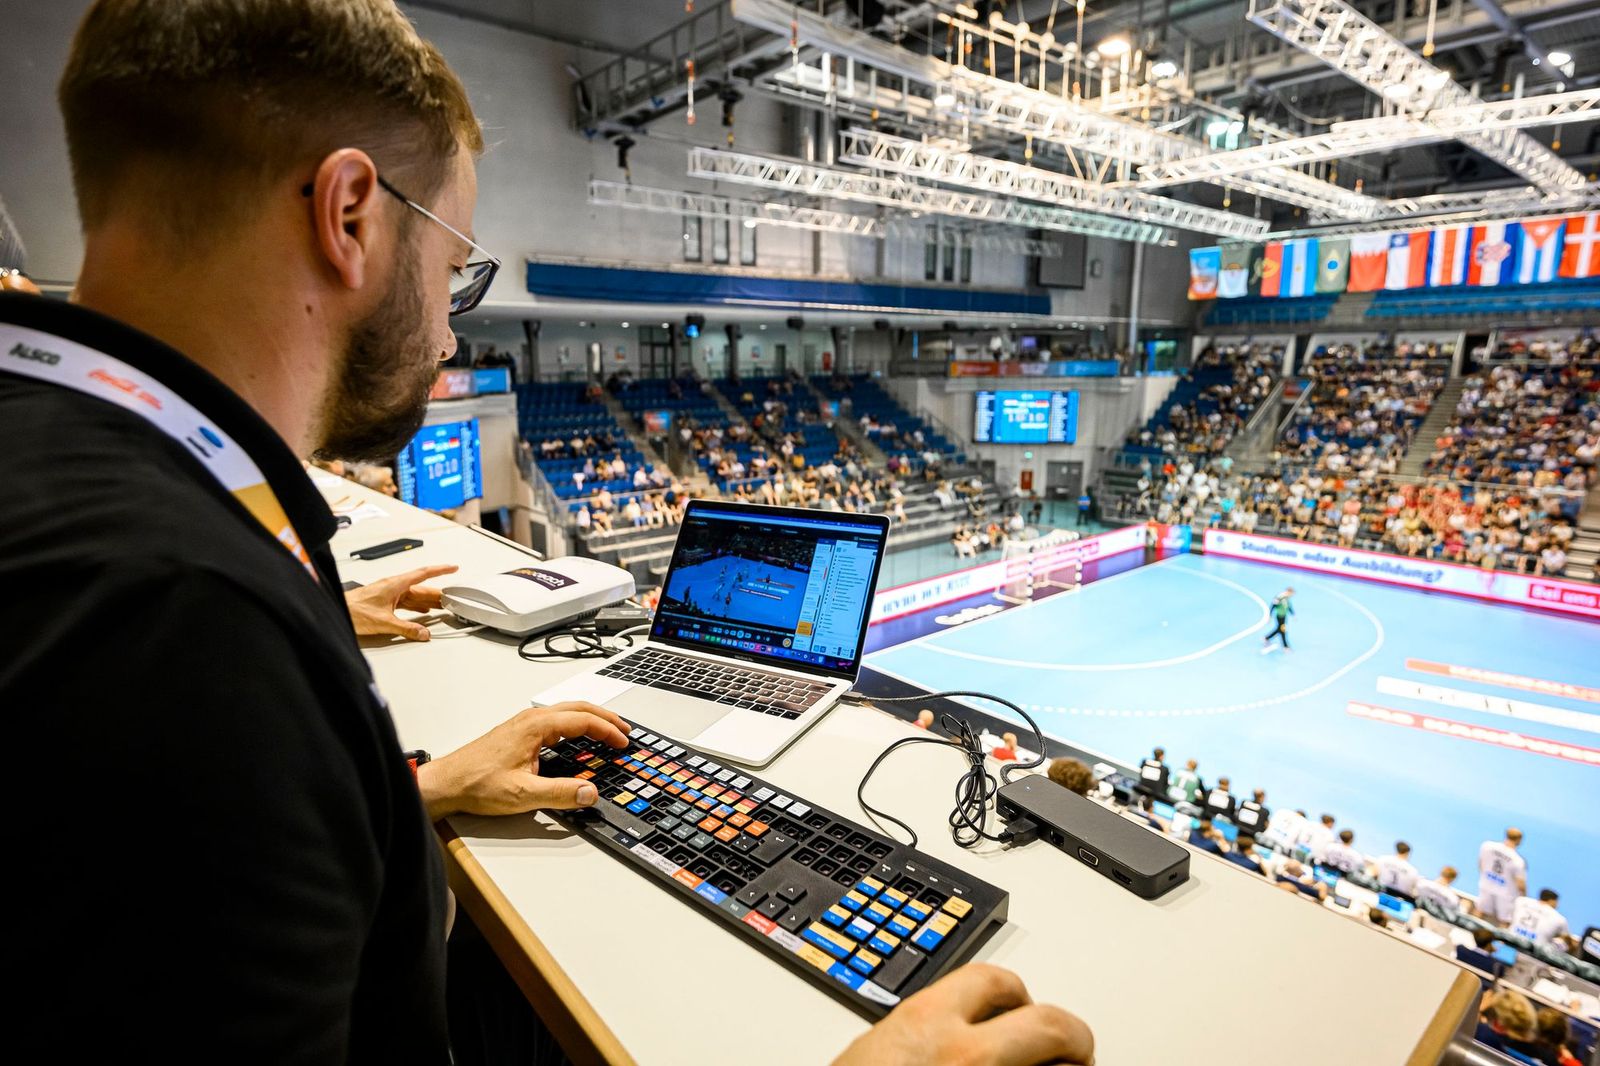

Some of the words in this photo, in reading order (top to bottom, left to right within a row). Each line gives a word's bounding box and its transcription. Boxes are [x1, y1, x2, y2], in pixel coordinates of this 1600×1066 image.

[1241, 541, 1298, 559] Studium
[1303, 552, 1336, 565] oder
[1342, 556, 1444, 583] Ausbildung?
